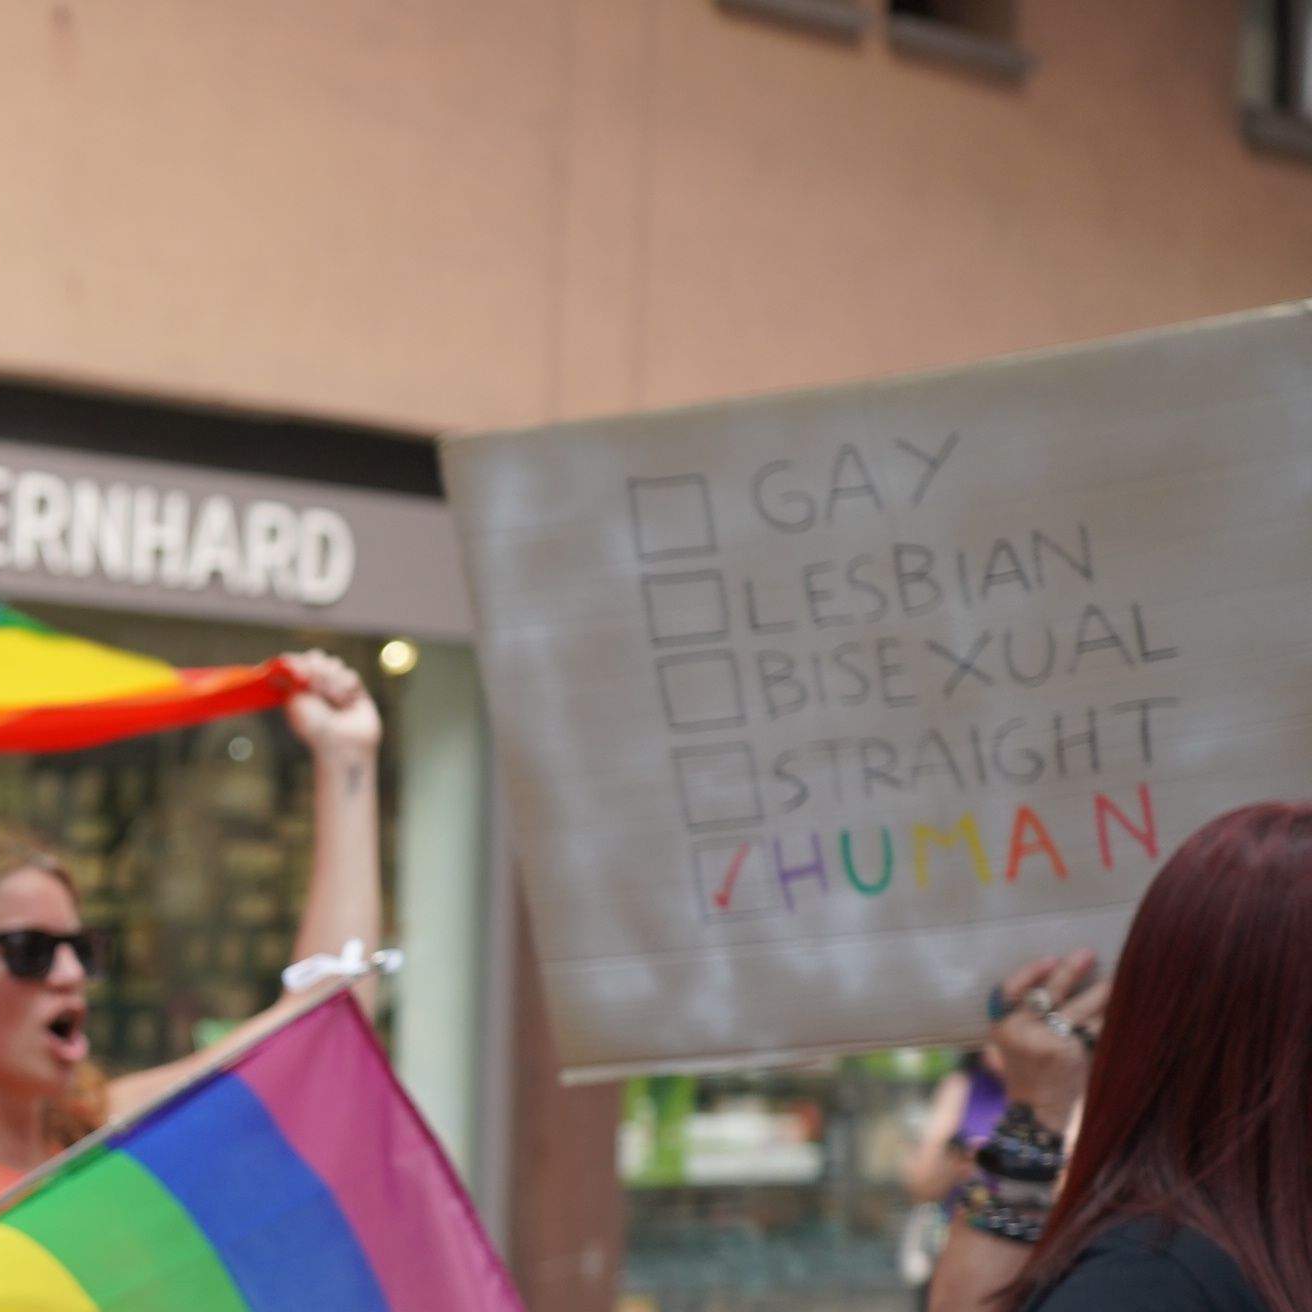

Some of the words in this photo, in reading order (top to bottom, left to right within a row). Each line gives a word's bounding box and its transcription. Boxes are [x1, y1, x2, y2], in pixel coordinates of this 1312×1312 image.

[750, 430, 960, 534] GAY
[742, 525, 1095, 633] LESBIAN
[756, 600, 1180, 722] BISEXUAL
[774, 697, 1182, 814] STRAIGHT
[776, 782, 1160, 912] HUMAN
